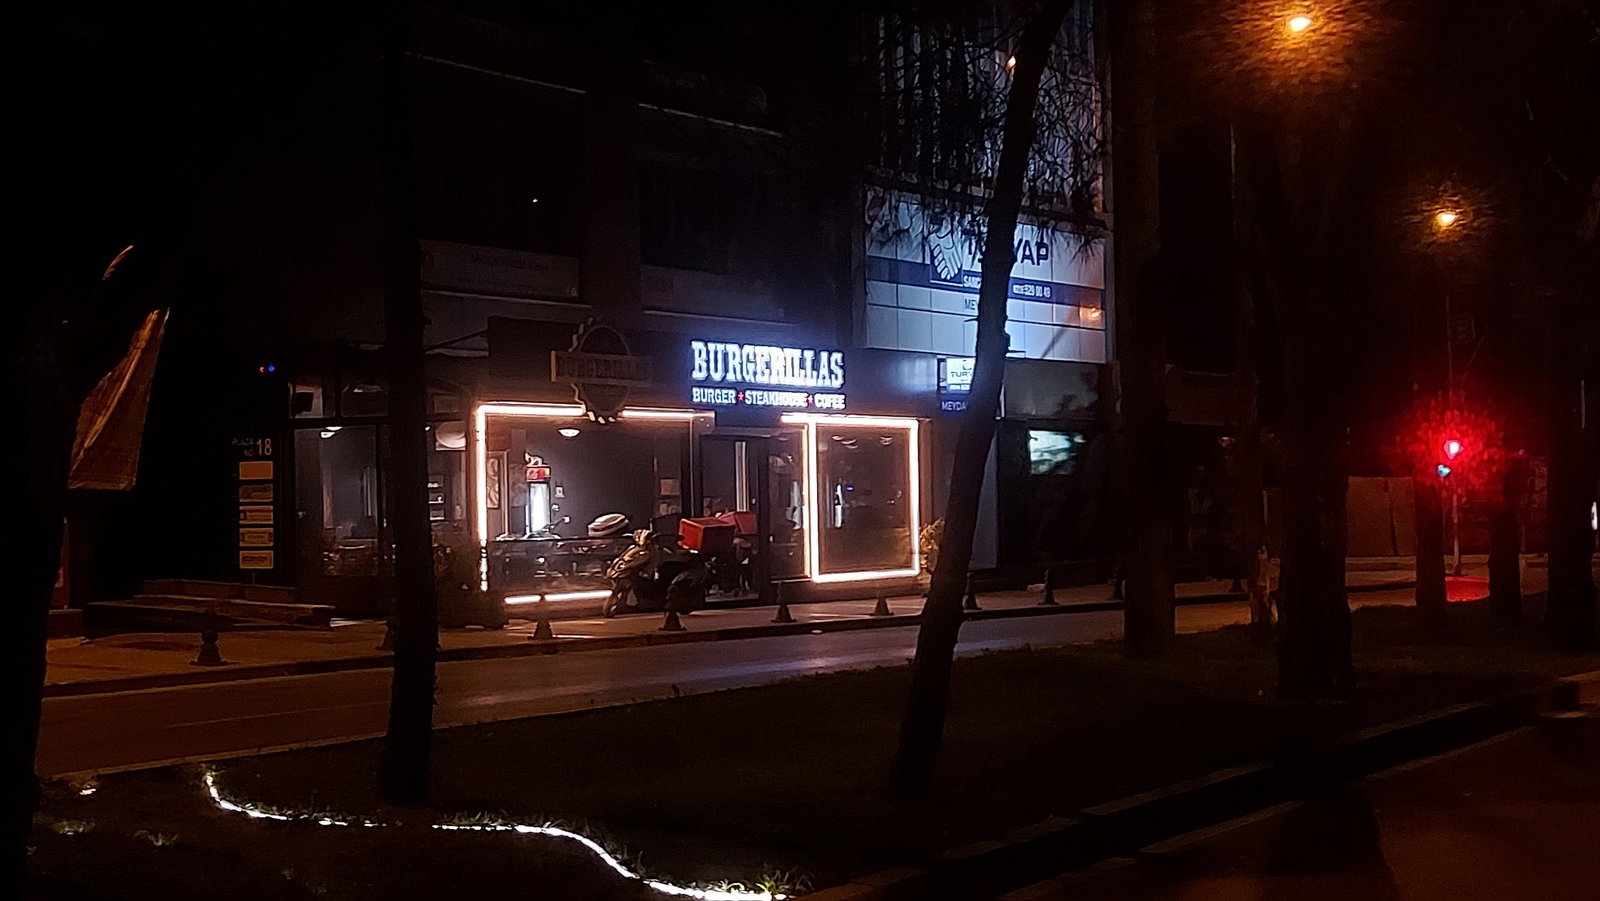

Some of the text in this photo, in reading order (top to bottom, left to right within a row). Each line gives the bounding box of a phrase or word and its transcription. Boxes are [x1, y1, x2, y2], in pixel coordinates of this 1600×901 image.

[691, 341, 845, 388] BURGERILLAS
[692, 387, 846, 409] BURGER STEAKHOUSE COFEE
[256, 438, 272, 456] 18
